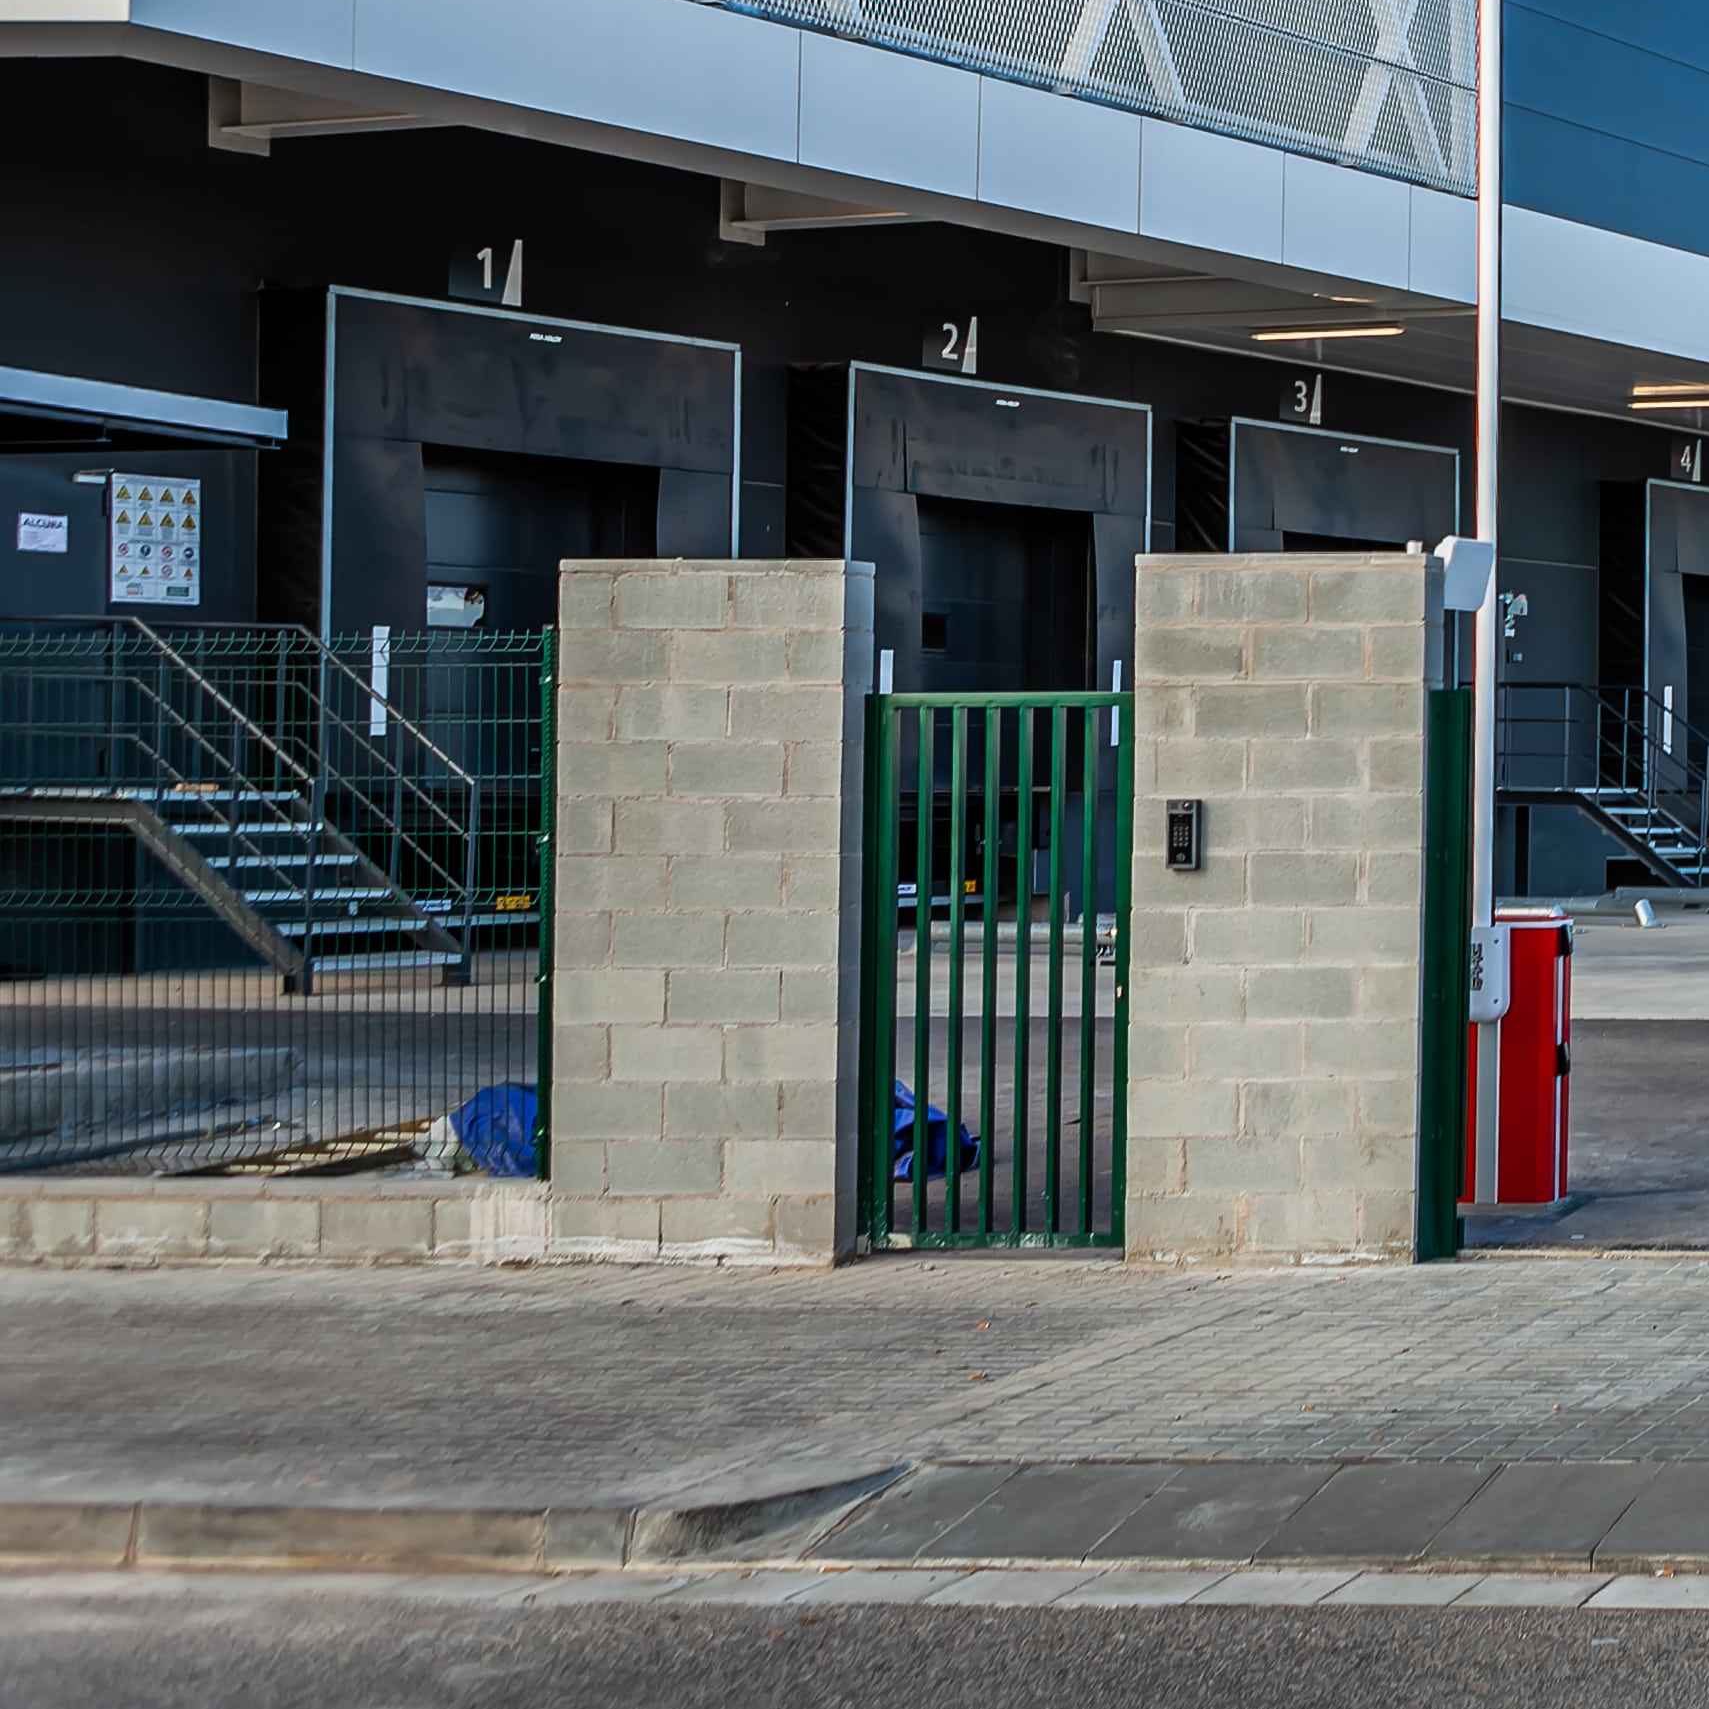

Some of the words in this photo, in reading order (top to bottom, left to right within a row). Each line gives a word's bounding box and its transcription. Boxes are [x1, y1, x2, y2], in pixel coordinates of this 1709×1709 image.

[476, 247, 492, 290] 1
[941, 322, 959, 361] 2
[1294, 380, 1307, 413] 3
[1680, 445, 1692, 473] 4
